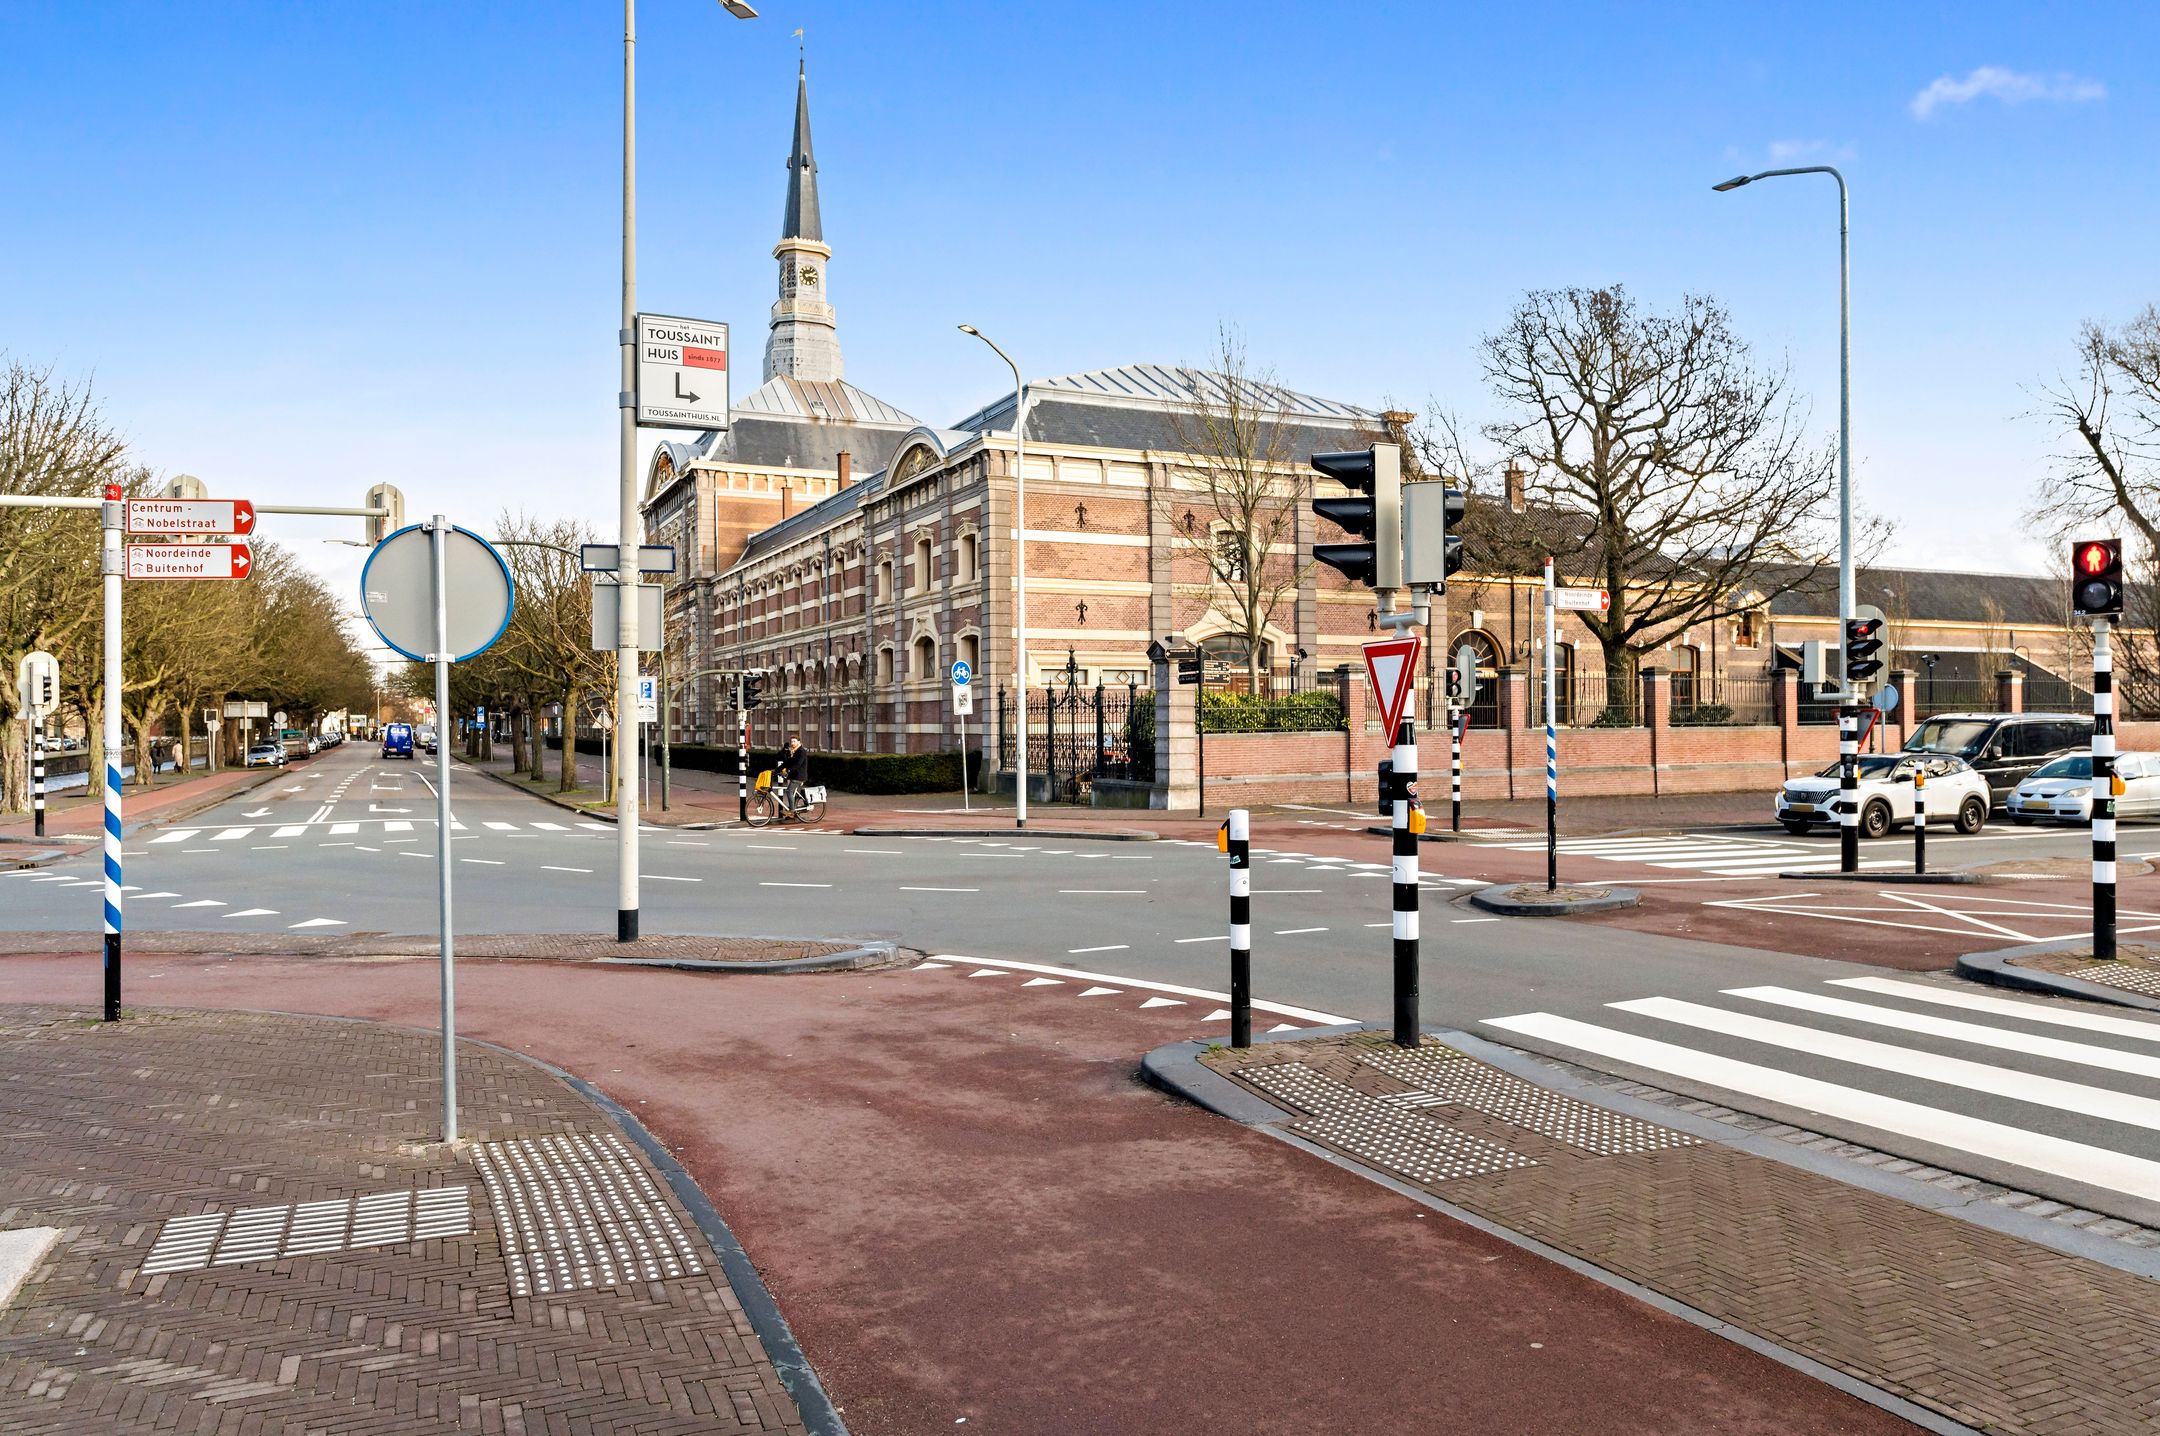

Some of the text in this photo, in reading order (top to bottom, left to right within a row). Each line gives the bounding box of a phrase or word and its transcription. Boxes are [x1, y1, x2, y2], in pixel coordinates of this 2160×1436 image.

[648, 328, 721, 346] TOUSSAINT
[648, 348, 679, 360] HUIS
[688, 353, 721, 364] sinds 1877
[648, 408, 721, 422] TOUSSAINTHUIS.NL
[131, 503, 183, 513] Centrum
[147, 518, 217, 528] Nobelstraat
[146, 548, 212, 558] Noordeinde
[146, 563, 204, 573] Buitenhof
[642, 682, 650, 692] P
